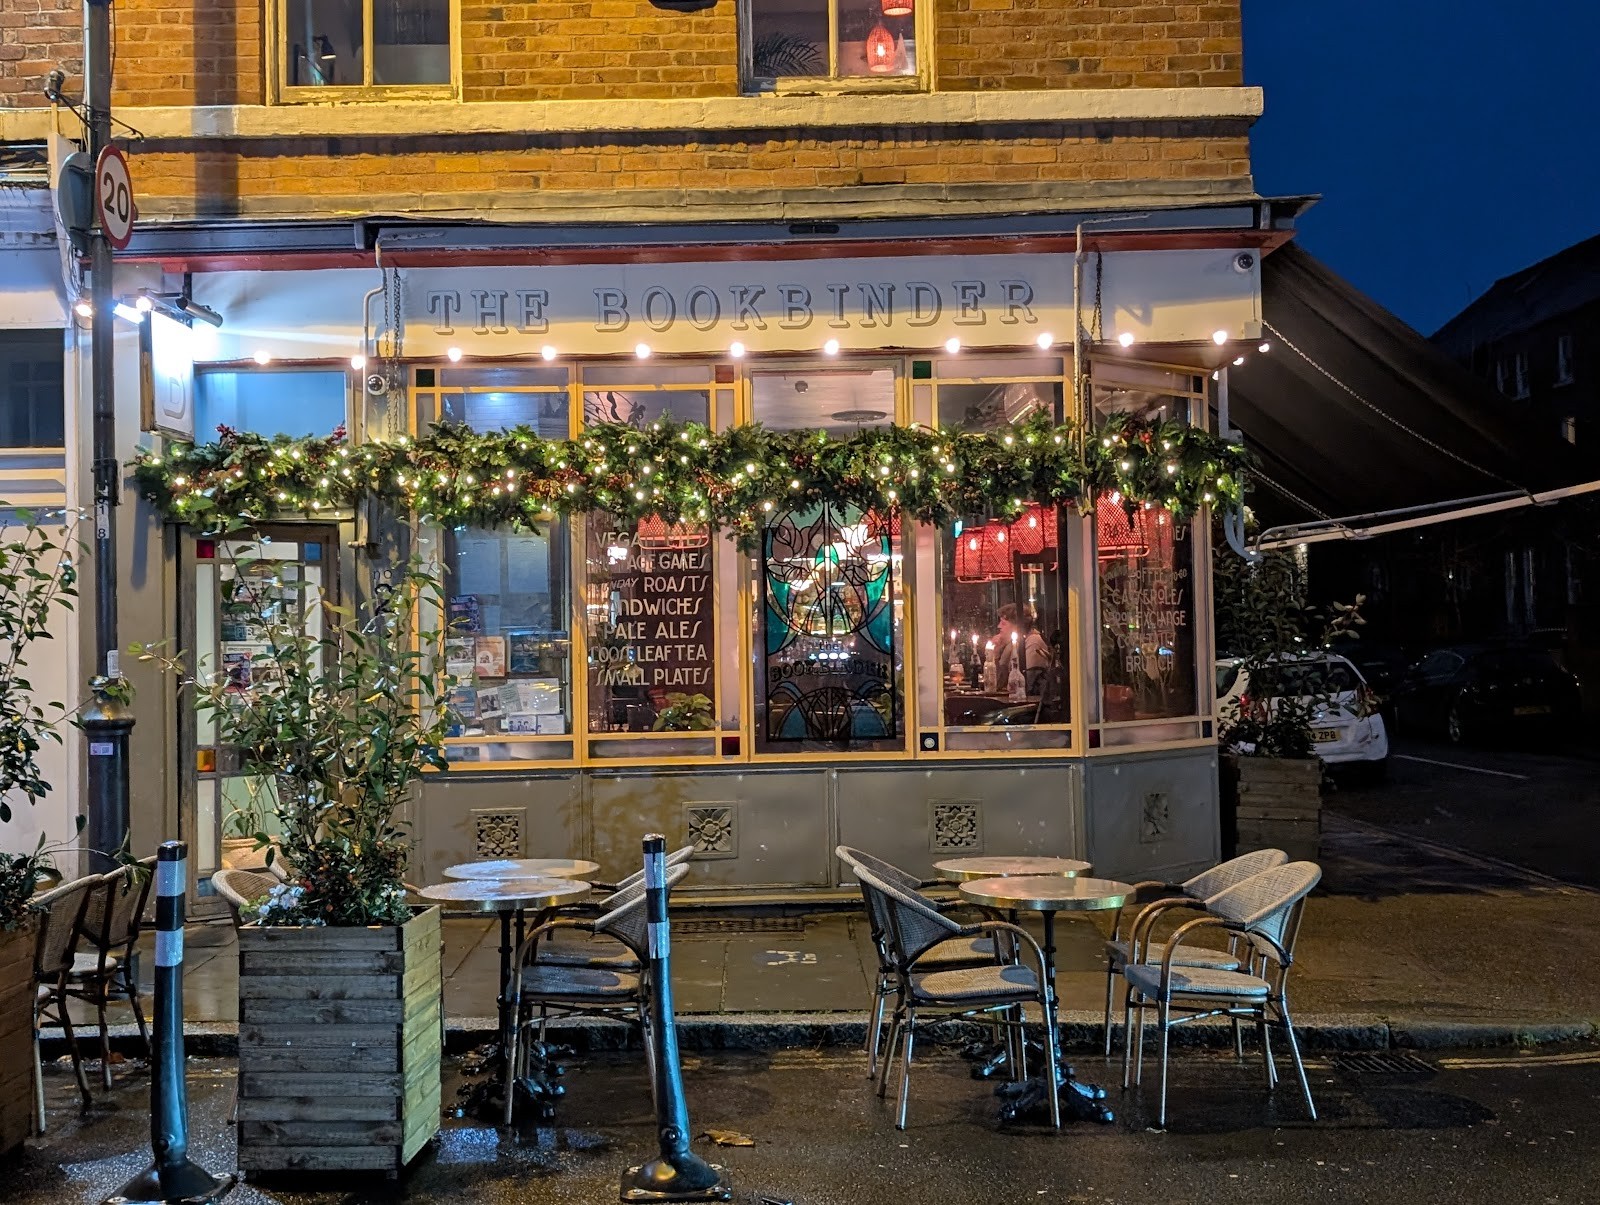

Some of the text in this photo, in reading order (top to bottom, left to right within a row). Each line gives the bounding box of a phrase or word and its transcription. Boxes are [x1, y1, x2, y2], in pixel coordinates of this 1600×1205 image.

[103, 171, 129, 224] 20
[426, 280, 1038, 336] THE BOOKBINDER
[659, 553, 709, 570] GAMES
[643, 575, 709, 593] ROASTS
[617, 597, 704, 616] NDWICHES
[603, 620, 702, 640] PALE ALES
[637, 645, 674, 662] LEAF
[674, 644, 708, 661] TEA
[595, 666, 711, 686] SMALL PLATES
